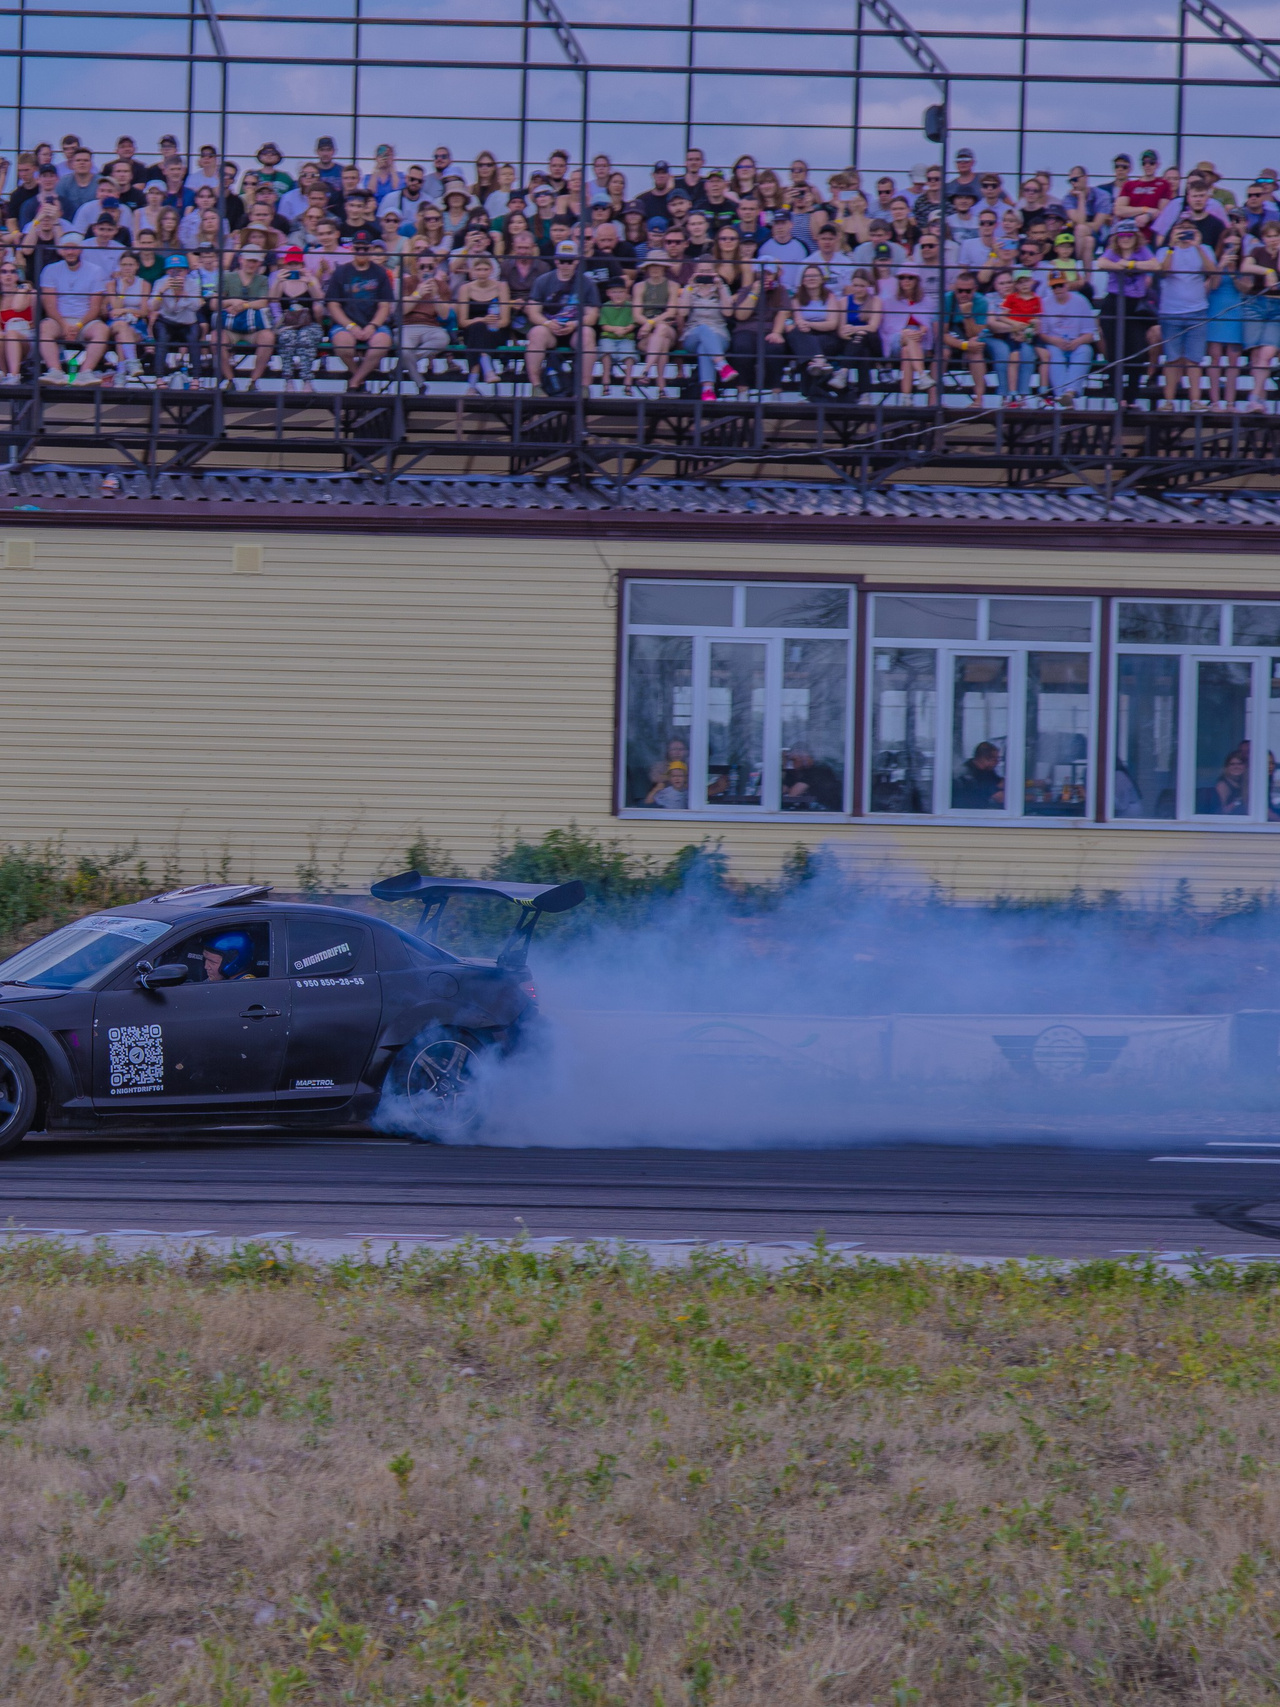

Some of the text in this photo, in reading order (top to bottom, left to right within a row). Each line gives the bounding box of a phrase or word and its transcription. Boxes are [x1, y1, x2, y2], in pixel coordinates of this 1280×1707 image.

[302, 943, 349, 967] NIGHTDRIFT61
[303, 979, 319, 987] 950
[320, 978, 364, 986] 850-28-55
[116, 1084, 164, 1095] NIGHTDRIFT61
